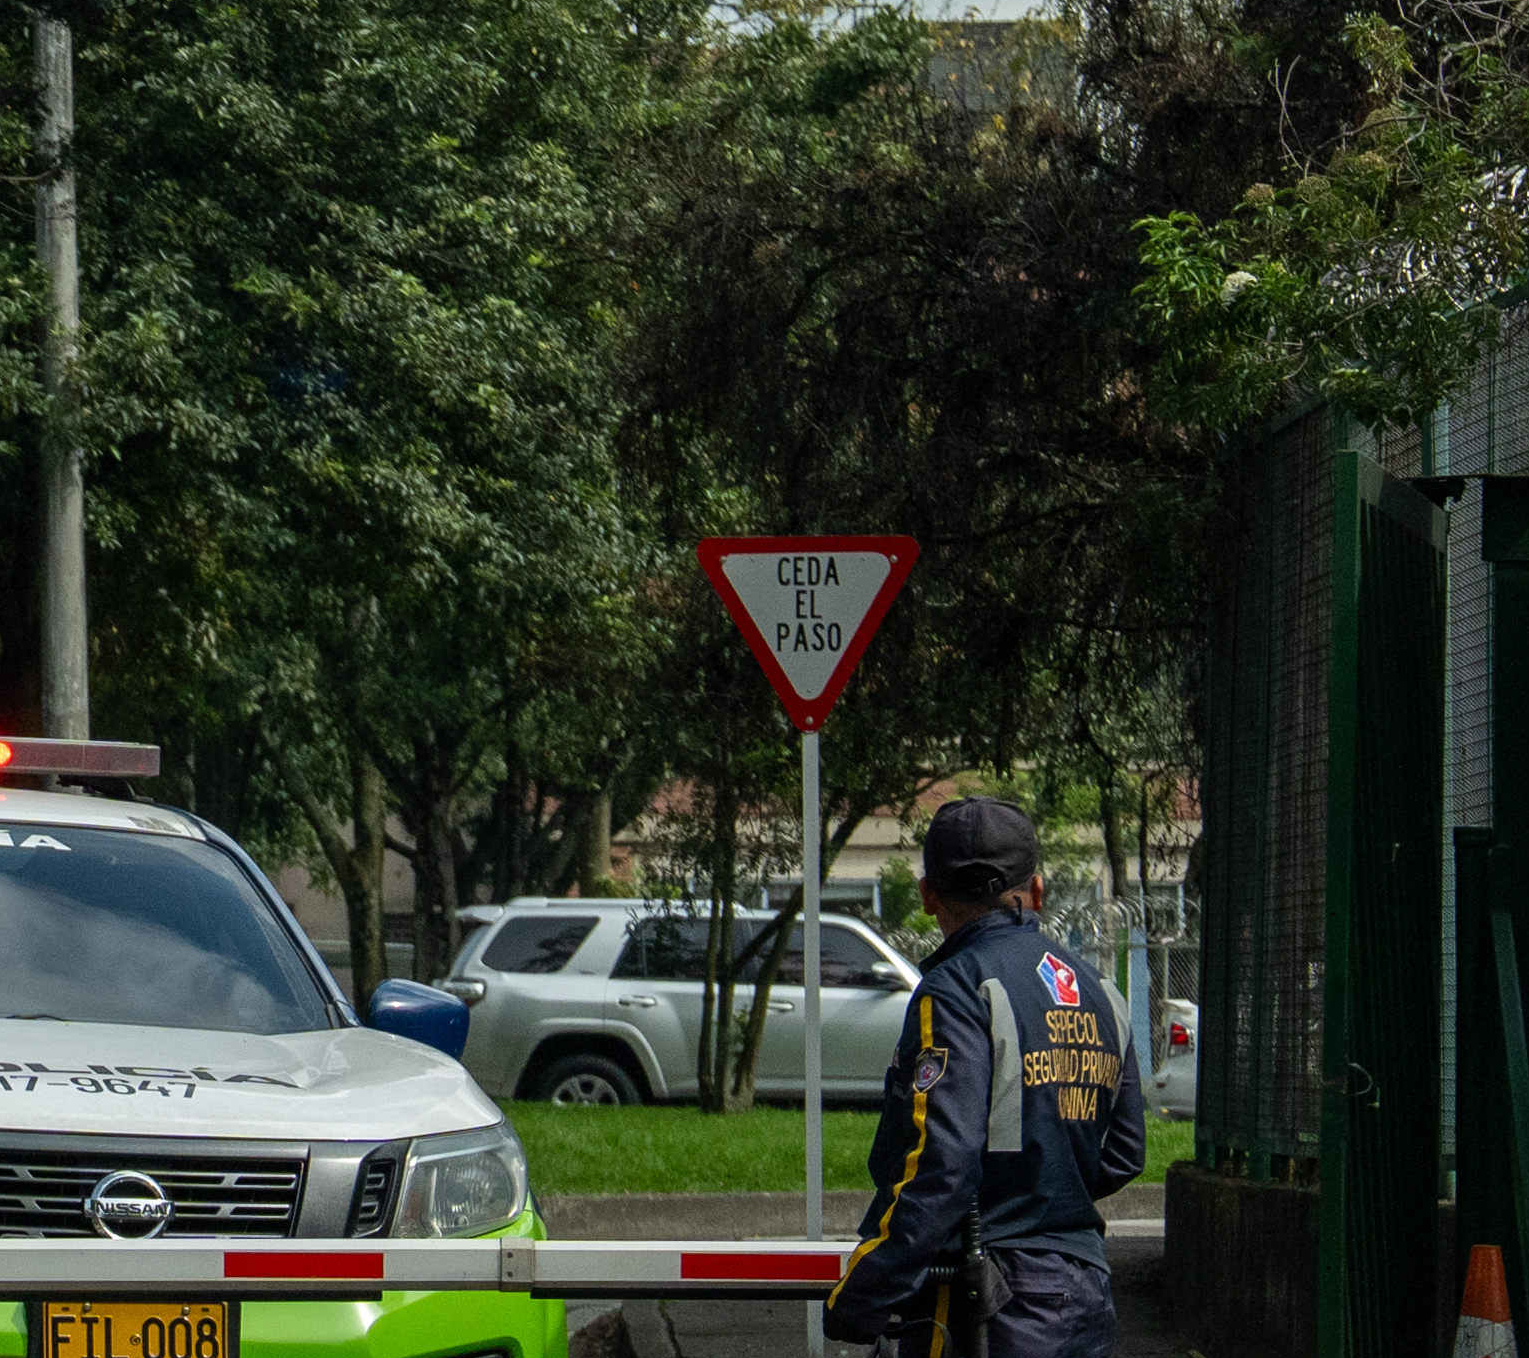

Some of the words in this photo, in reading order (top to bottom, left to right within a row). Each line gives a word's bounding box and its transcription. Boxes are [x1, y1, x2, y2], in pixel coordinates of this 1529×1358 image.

[777, 556, 840, 586] CEDA
[795, 589, 823, 619] EL
[776, 622, 842, 652] PASO
[1045, 1010, 1103, 1046] SEPECOL
[1023, 1049, 1079, 1086] SEGUD
[1081, 1050, 1120, 1089] PRIVAD
[94, 1202, 169, 1216] NISSAN
